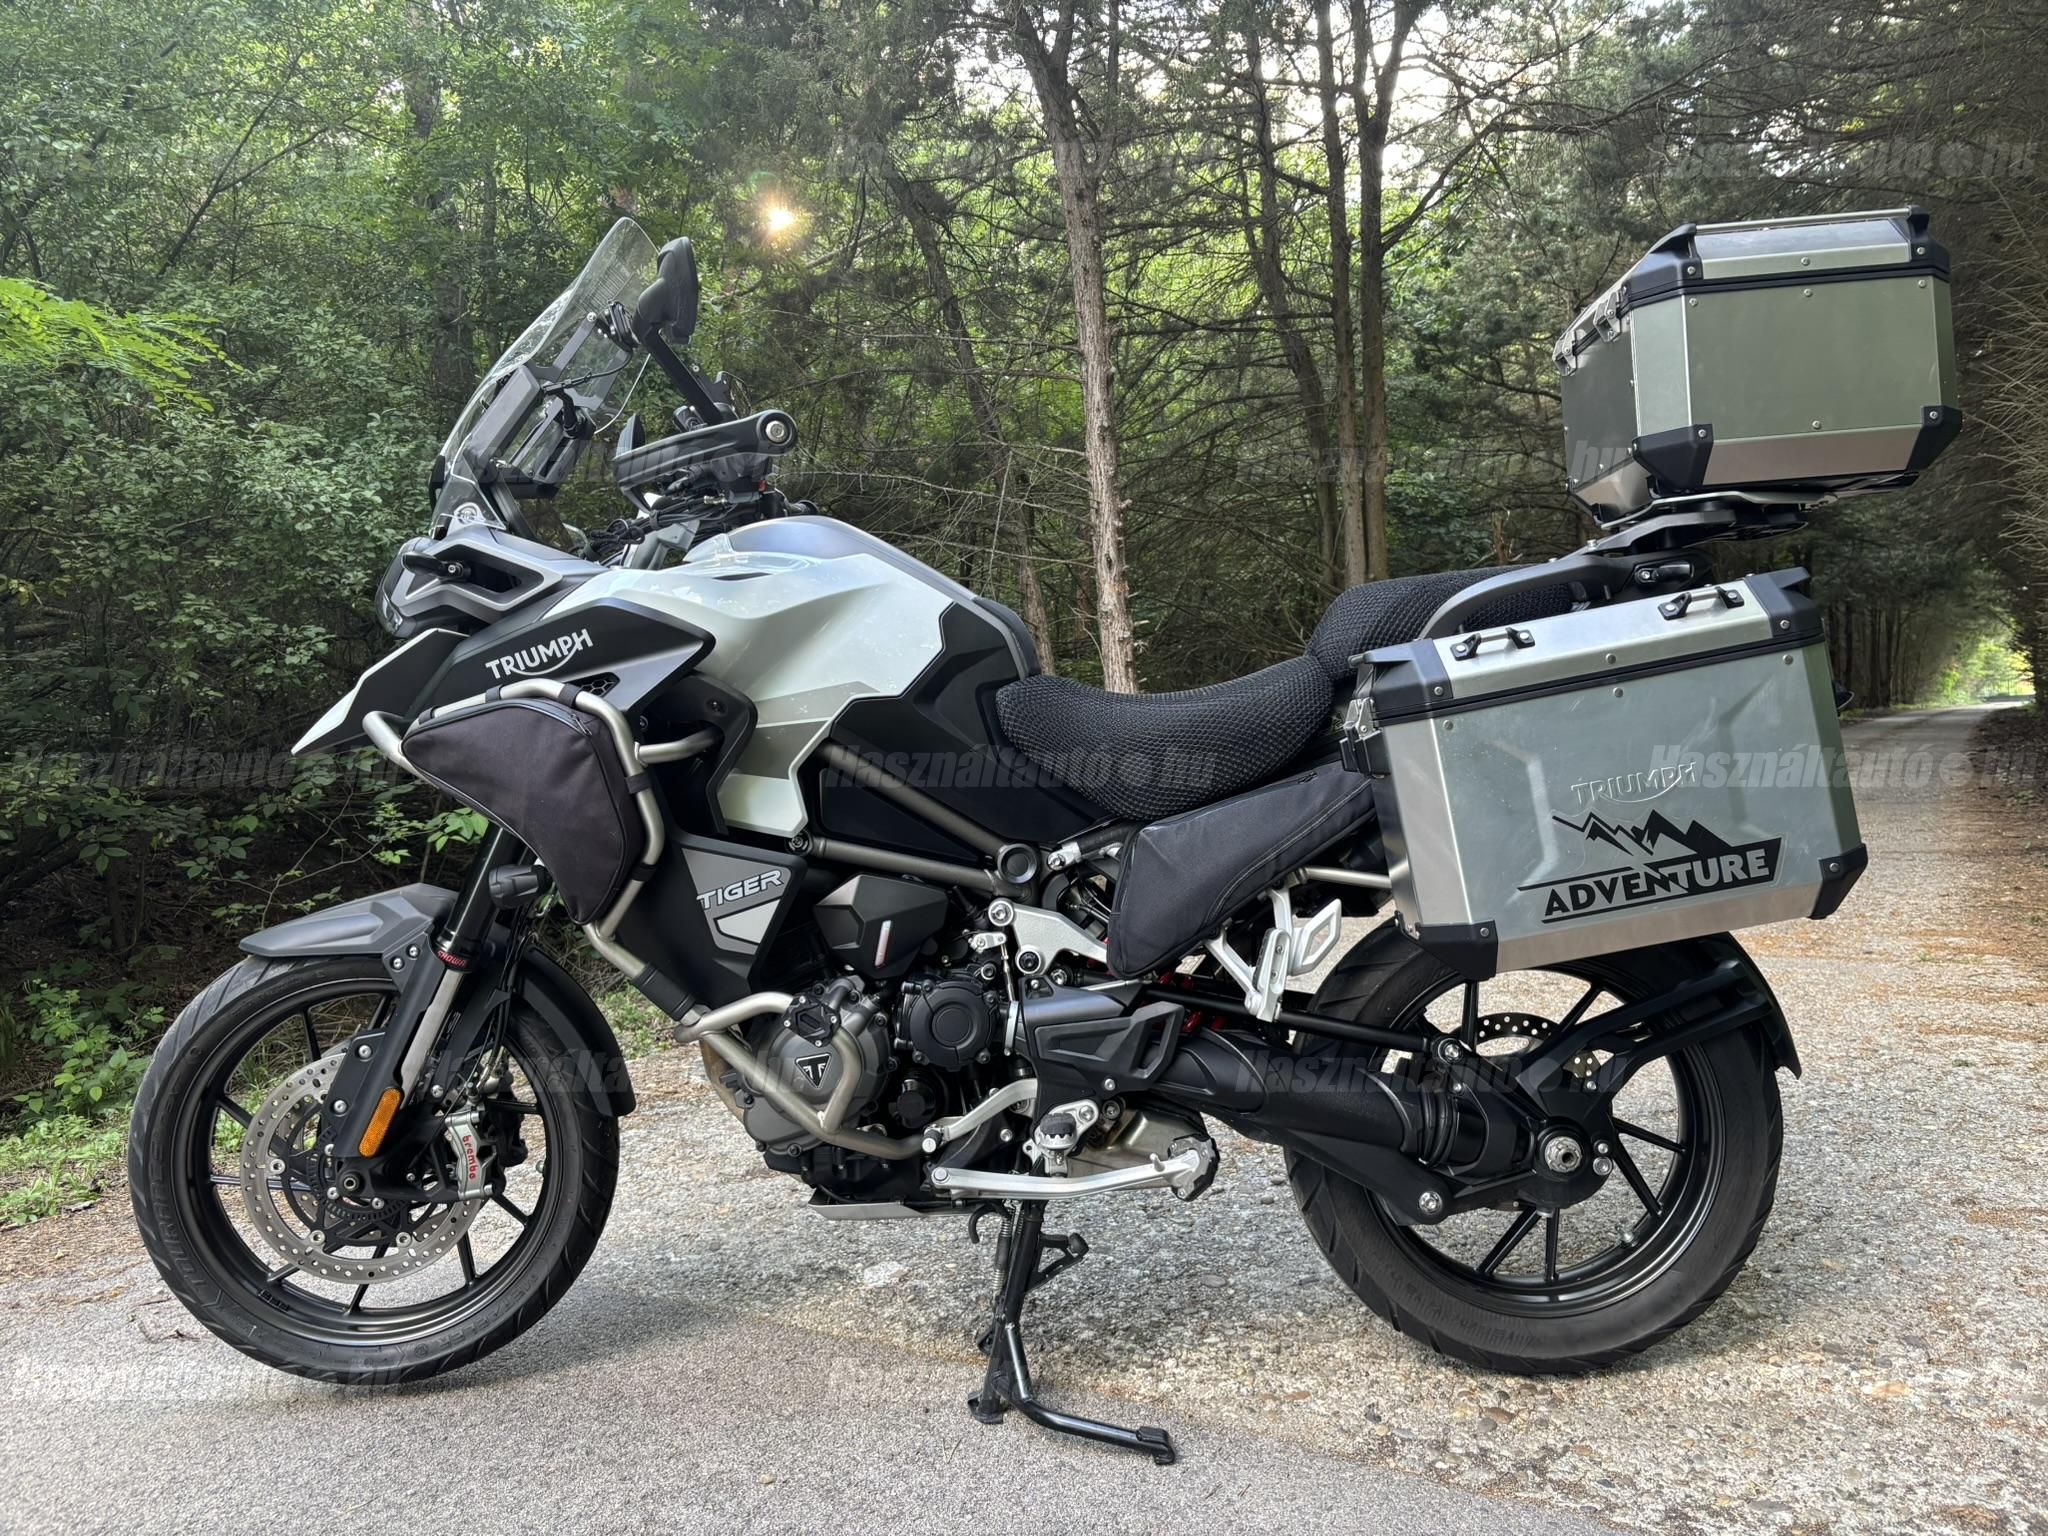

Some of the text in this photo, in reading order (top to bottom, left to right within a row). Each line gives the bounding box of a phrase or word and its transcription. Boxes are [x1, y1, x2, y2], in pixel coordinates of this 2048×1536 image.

[485, 628, 594, 679] TRIUMPH
[1571, 761, 1697, 803] TRIUMPH
[696, 869, 784, 910] TIGER
[1545, 849, 1770, 917] ADVENTURE
[462, 1134, 479, 1180] brembo
